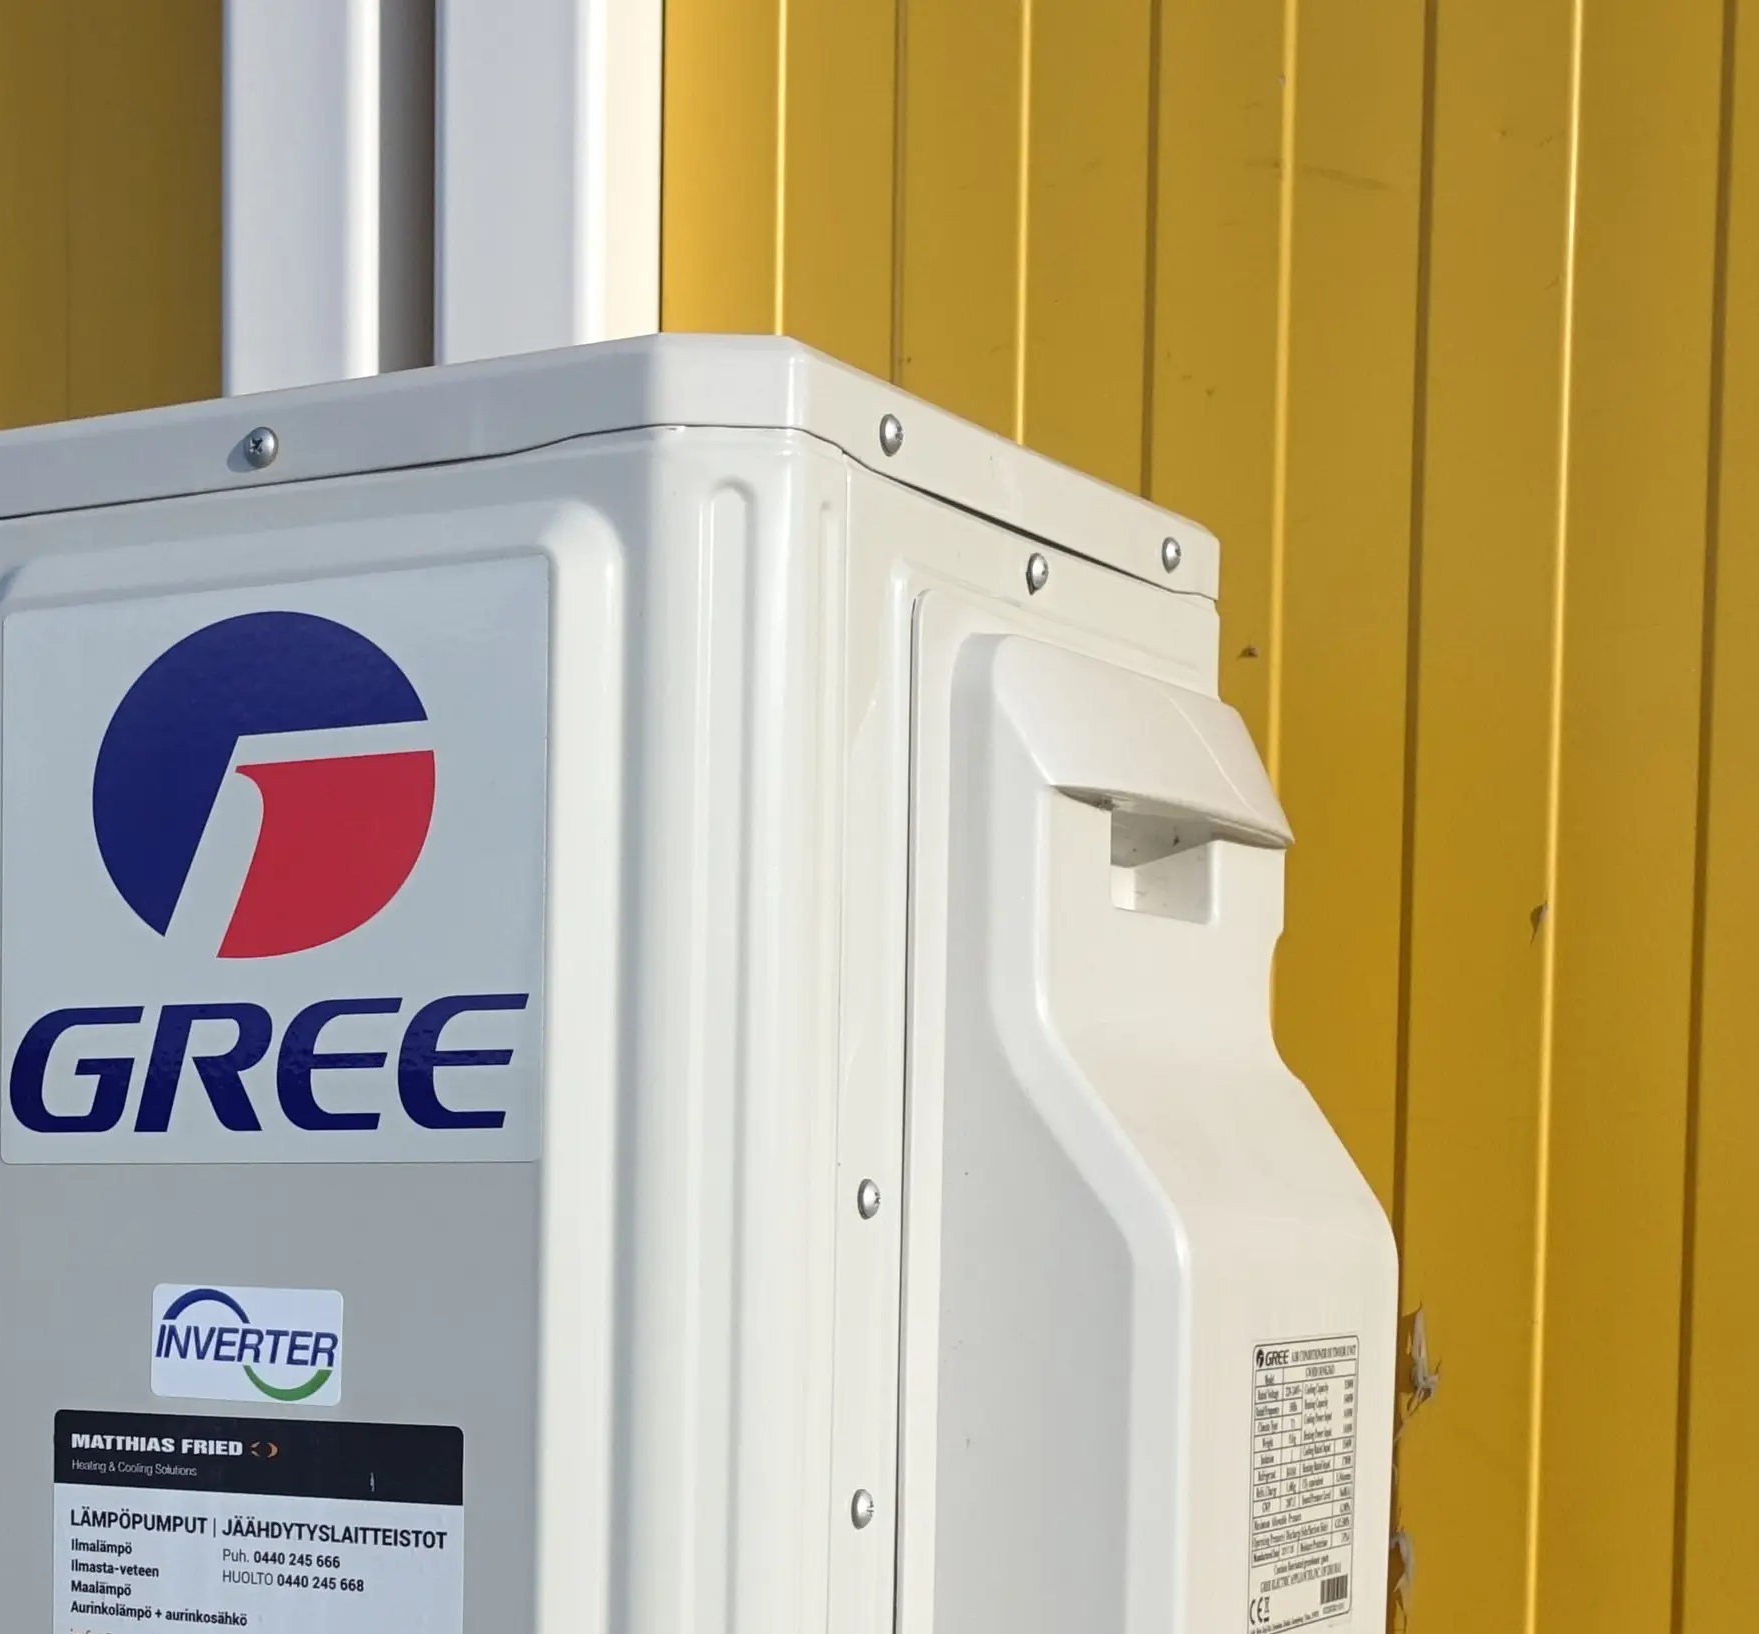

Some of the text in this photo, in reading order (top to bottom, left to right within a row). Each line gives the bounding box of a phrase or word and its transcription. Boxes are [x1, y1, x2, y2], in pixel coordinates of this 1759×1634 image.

[9, 993, 528, 1134] GREE
[155, 1324, 338, 1367] INVERTER
[1265, 1349, 1290, 1367] GREE
[71, 1433, 243, 1456] MATTHIAS FRIED
[72, 1459, 197, 1476] Heating & Cooling Solutions
[70, 1506, 208, 1534] LÄMPÖPUMPUT
[222, 1515, 448, 1549] JÄÄHDYTYSLAITTEISTOT
[71, 1538, 132, 1557] Ilmalämpö
[222, 1548, 341, 1569] Puh. 0440 245 666
[71, 1559, 159, 1577] Ilmasta-veteen
[71, 1580, 132, 1598] Maalämpö
[222, 1569, 364, 1592] HUOLTO 0440 245 668
[70, 1600, 152, 1621] Aurinkolämpö
[165, 1608, 248, 1626] aurinkosähkö
